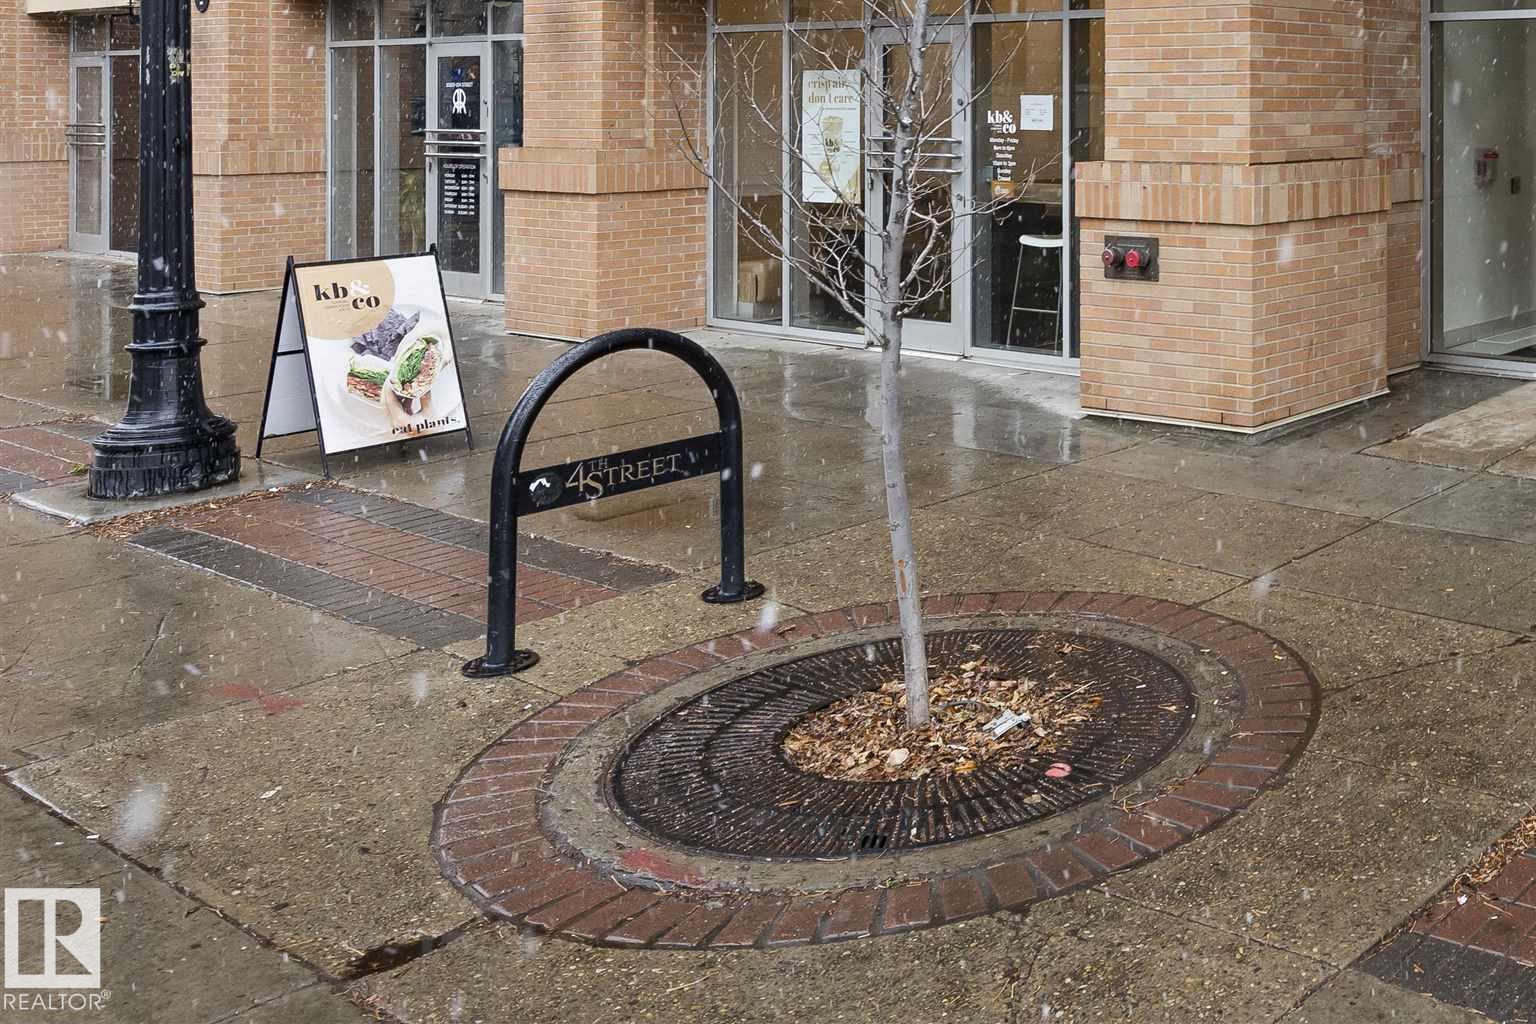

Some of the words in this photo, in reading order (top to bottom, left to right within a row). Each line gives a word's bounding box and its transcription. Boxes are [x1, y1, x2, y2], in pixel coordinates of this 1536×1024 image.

[1002, 123, 1016, 133] co
[352, 296, 380, 309] co
[585, 453, 681, 499] STREET
